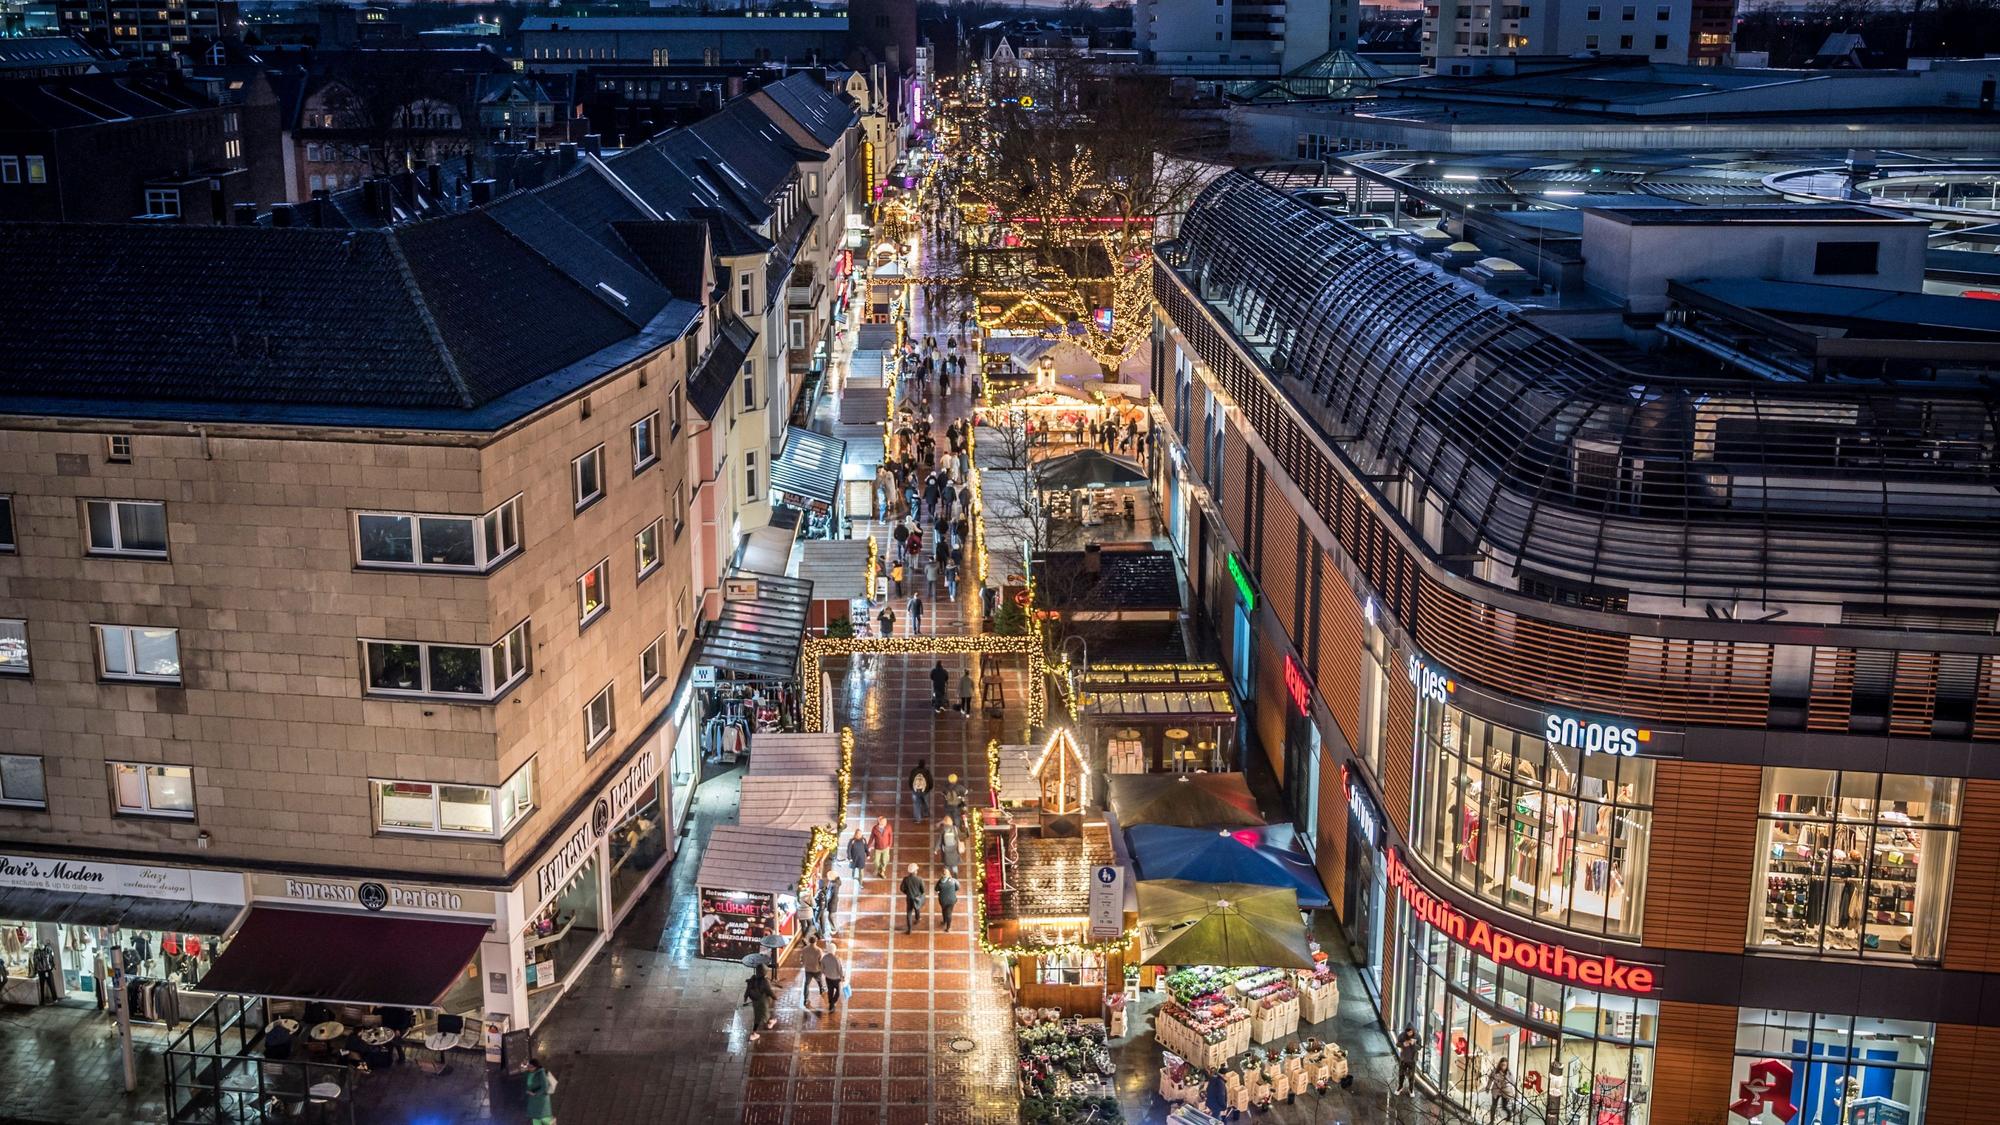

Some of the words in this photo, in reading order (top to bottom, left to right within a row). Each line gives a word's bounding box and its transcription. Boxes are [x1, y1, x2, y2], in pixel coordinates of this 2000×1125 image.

[1285, 655, 1309, 718] REWE
[1409, 654, 1447, 704] snipes
[1546, 714, 1638, 757] snipes
[610, 751, 655, 820] Perfetto
[1350, 784, 1374, 847] SATURN
[43, 861, 105, 882] Moden
[52, 882, 61, 890] up
[63, 881, 70, 889] to
[72, 883, 88, 891] date
[537, 822, 592, 902] Espresso
[285, 879, 356, 902] Espresso
[390, 887, 462, 911] Perfetto
[715, 900, 761, 915] GLÜH-MET
[1395, 860, 1467, 941] Pinguin
[1468, 919, 1655, 993] Apotheke
